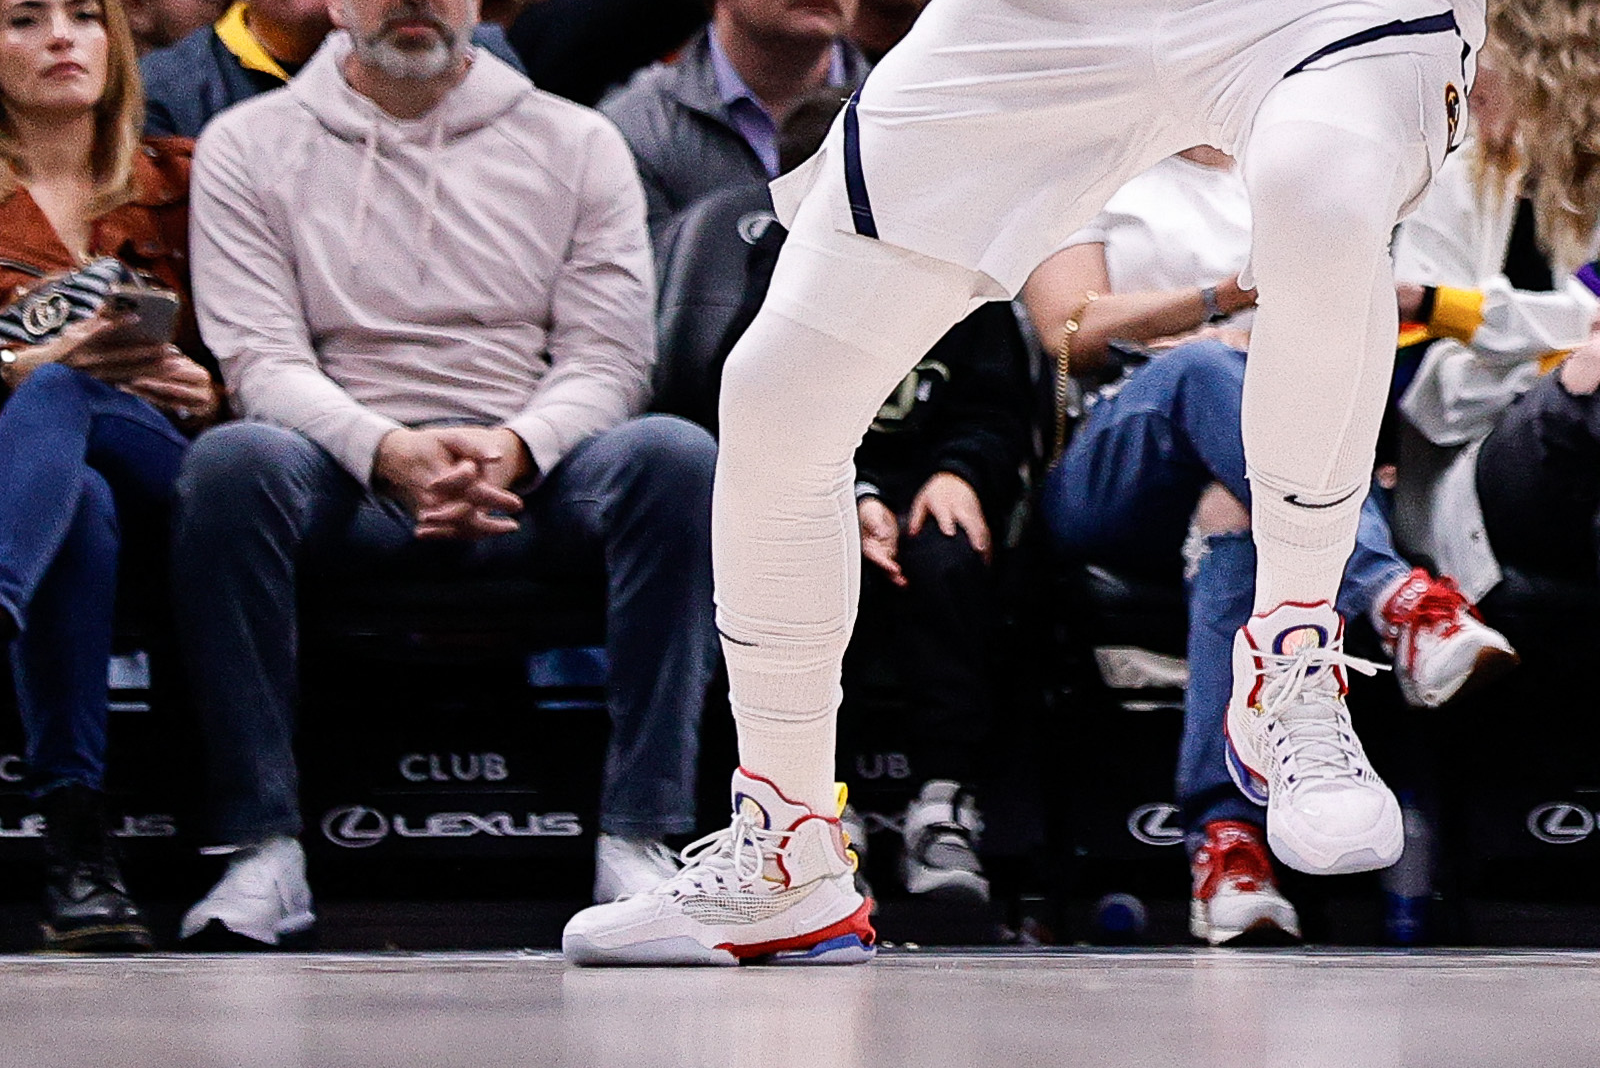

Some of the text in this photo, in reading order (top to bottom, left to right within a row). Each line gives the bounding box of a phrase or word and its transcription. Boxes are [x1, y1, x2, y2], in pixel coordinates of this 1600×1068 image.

[400, 752, 509, 781] CLUB
[856, 753, 911, 779] UB
[393, 811, 583, 837] LEXUS
